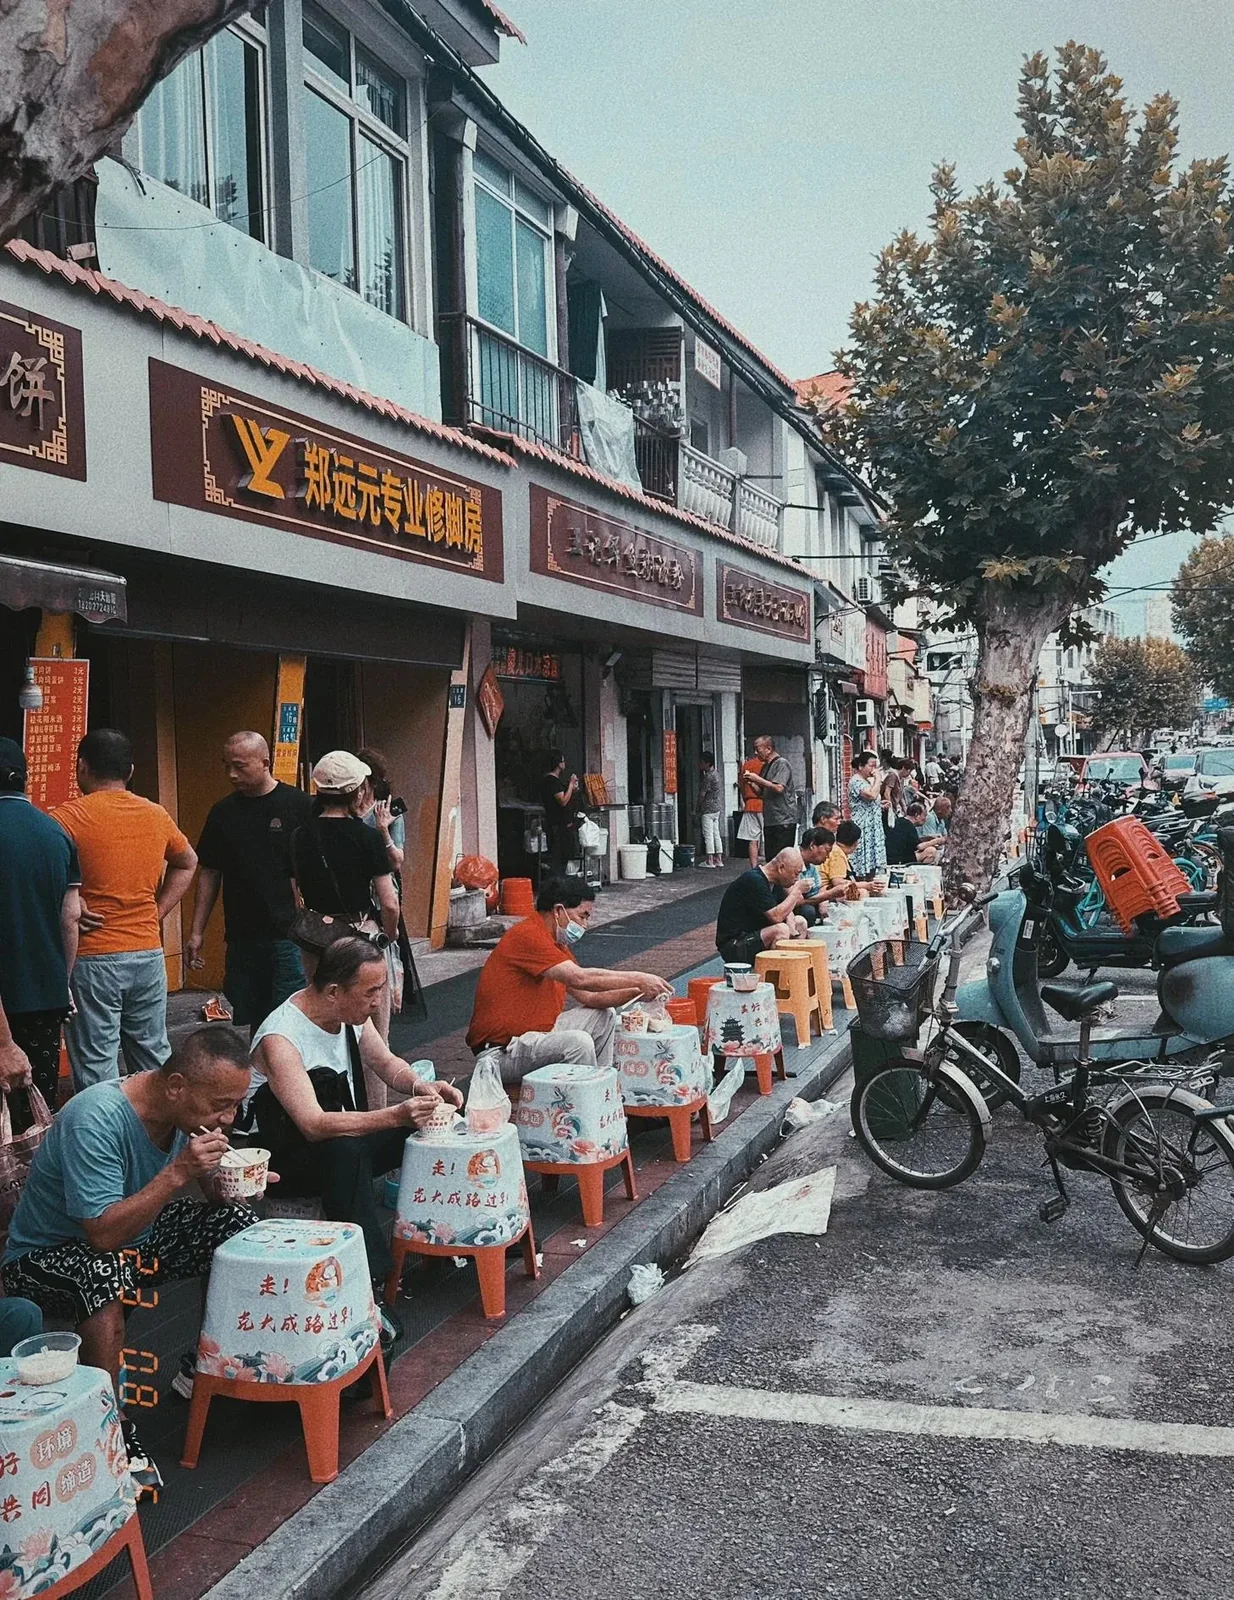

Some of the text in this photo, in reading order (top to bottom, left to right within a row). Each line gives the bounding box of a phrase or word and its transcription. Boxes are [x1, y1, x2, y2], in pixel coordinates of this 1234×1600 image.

[0, 351, 56, 431] 饼
[304, 438, 483, 554] 郑远元专业修脚房
[73, 676, 83, 685] 5元
[72, 686, 83, 694] 2元
[72, 696, 83, 704] 2元
[72, 705, 82, 713] 3元
